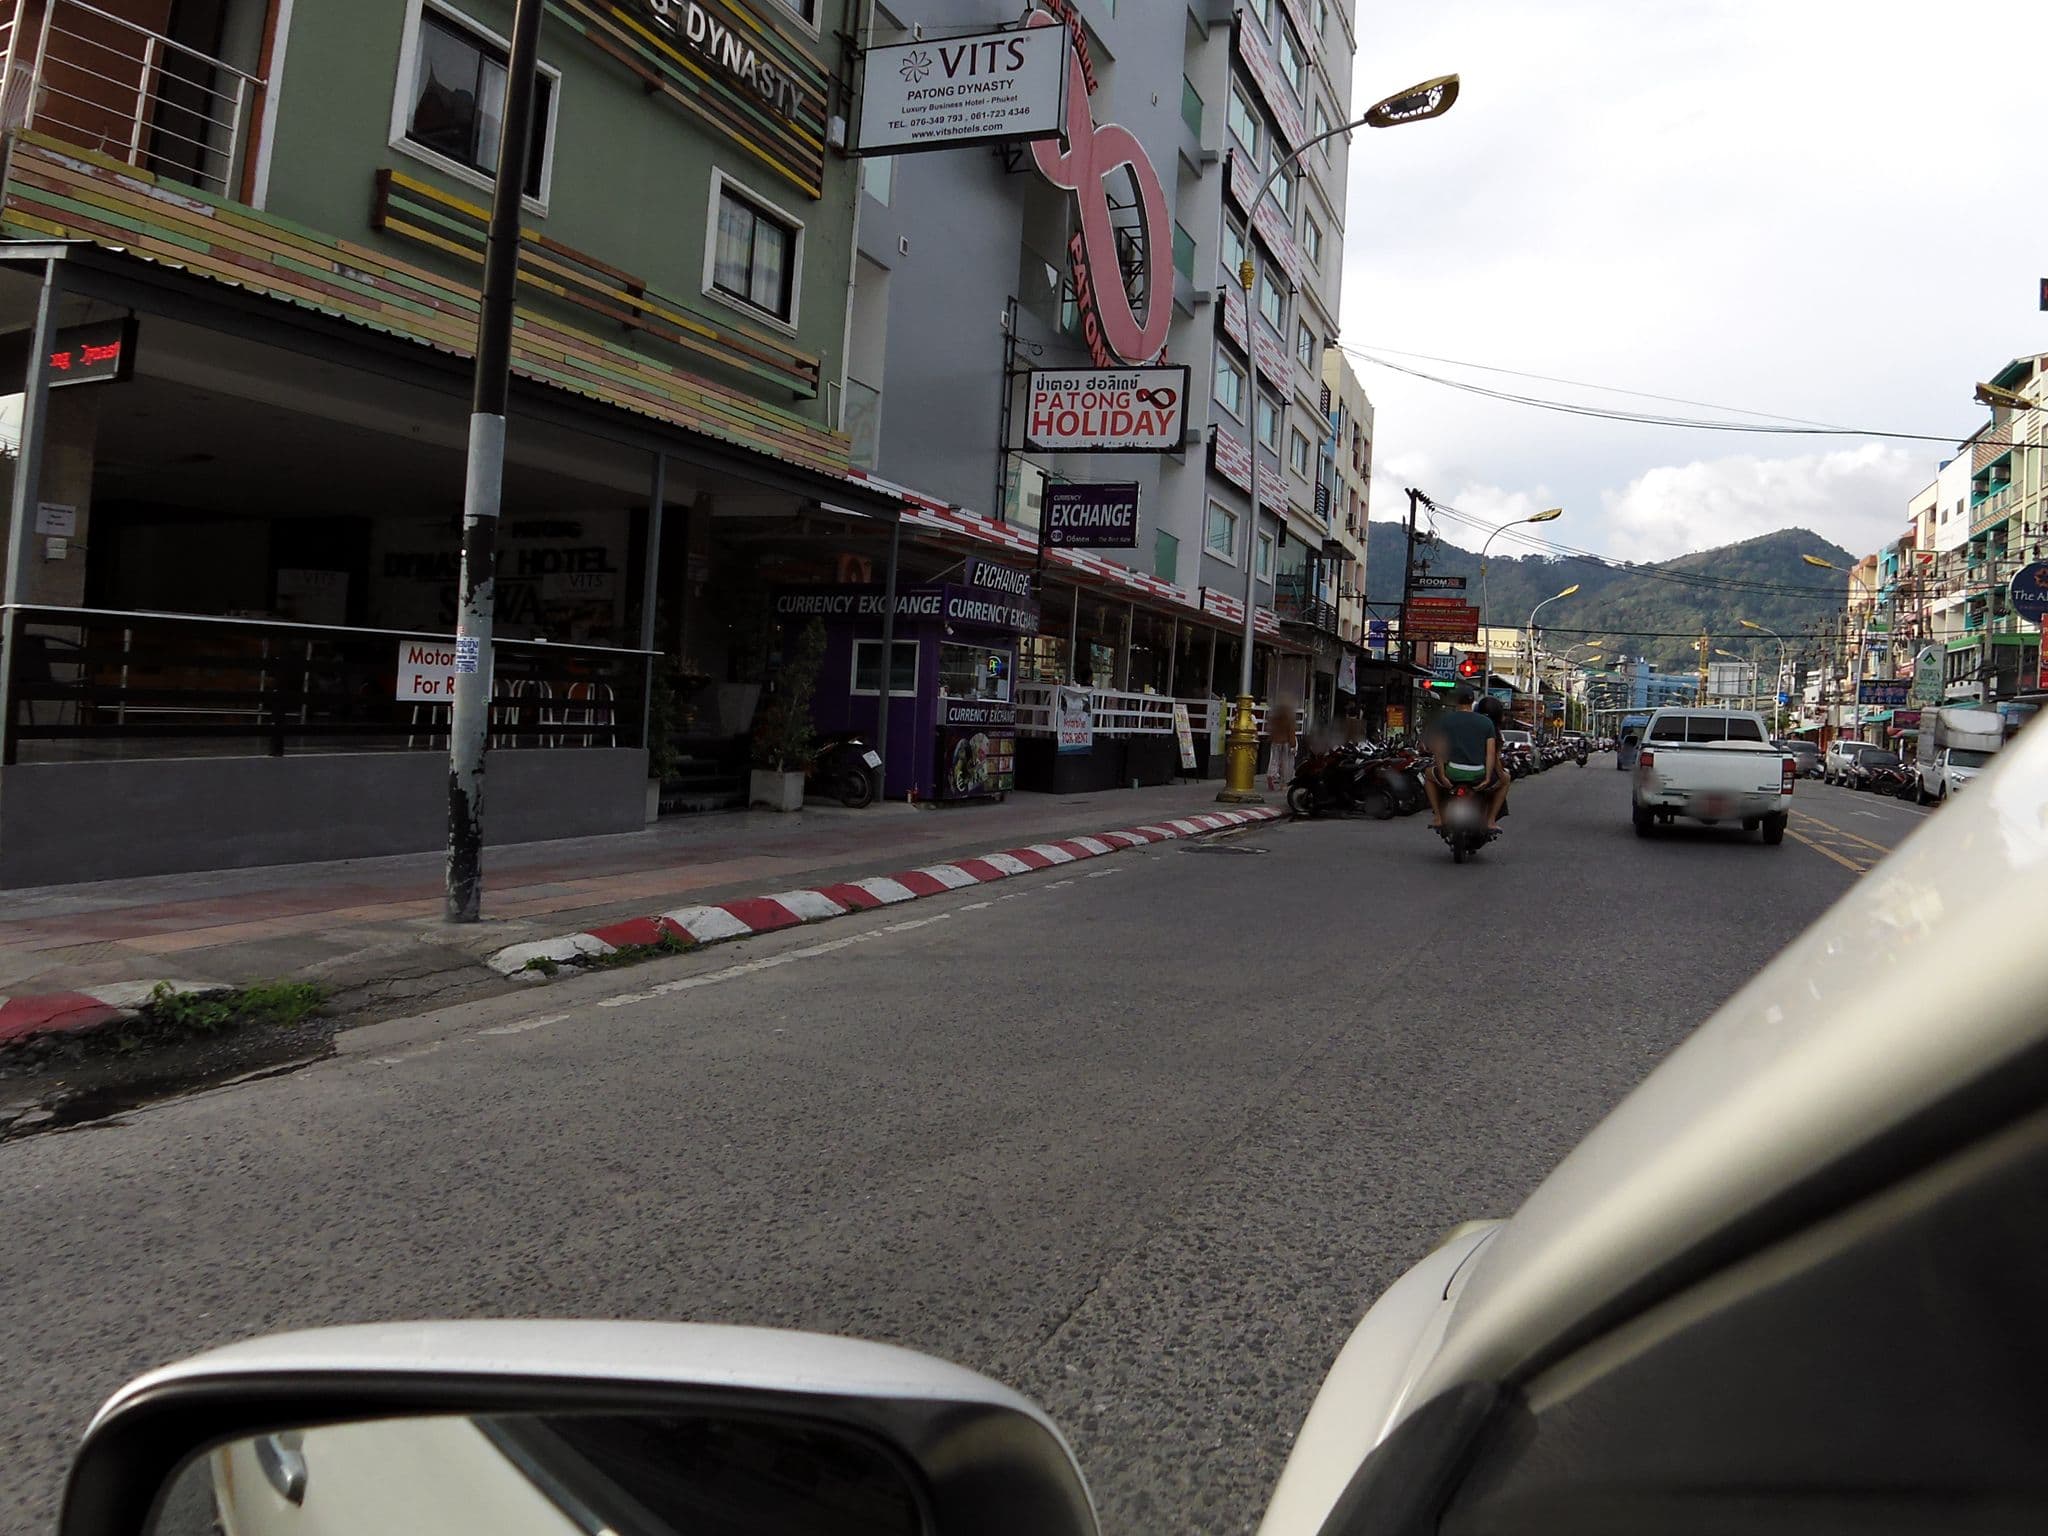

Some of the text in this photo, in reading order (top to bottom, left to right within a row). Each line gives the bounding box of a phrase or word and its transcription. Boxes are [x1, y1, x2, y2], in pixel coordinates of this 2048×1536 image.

[686, 2, 804, 119] DYNASTY
[938, 37, 1025, 79] VITS
[907, 79, 1015, 101] PATONG DYNASTY
[901, 105, 928, 115] Luxury
[929, 100, 963, 111] Business
[965, 97, 985, 107] Hotel
[991, 94, 1018, 105] Phuket
[910, 116, 945, 127] 076-349
[947, 113, 963, 122] 793
[970, 109, 1006, 121] 061-723
[1007, 107, 1030, 116] 4346
[911, 123, 1003, 139] www.vitshotels.com
[1036, 373, 1080, 390] ป่าตอง
[1034, 392, 1131, 410] PATONG
[1031, 410, 1176, 436] HOLIDAY
[1050, 504, 1133, 527] EXCHANGE
[518, 548, 616, 575] HOTEL
[974, 561, 1030, 597] EXCHANGE
[777, 595, 851, 613] CURRENCY
[2013, 590, 2034, 601] The
[949, 598, 1008, 625] CURRENCY
[408, 646, 456, 666] Motor
[414, 674, 440, 694] For
[948, 708, 1015, 724] CURRENCY EXCHANGE
